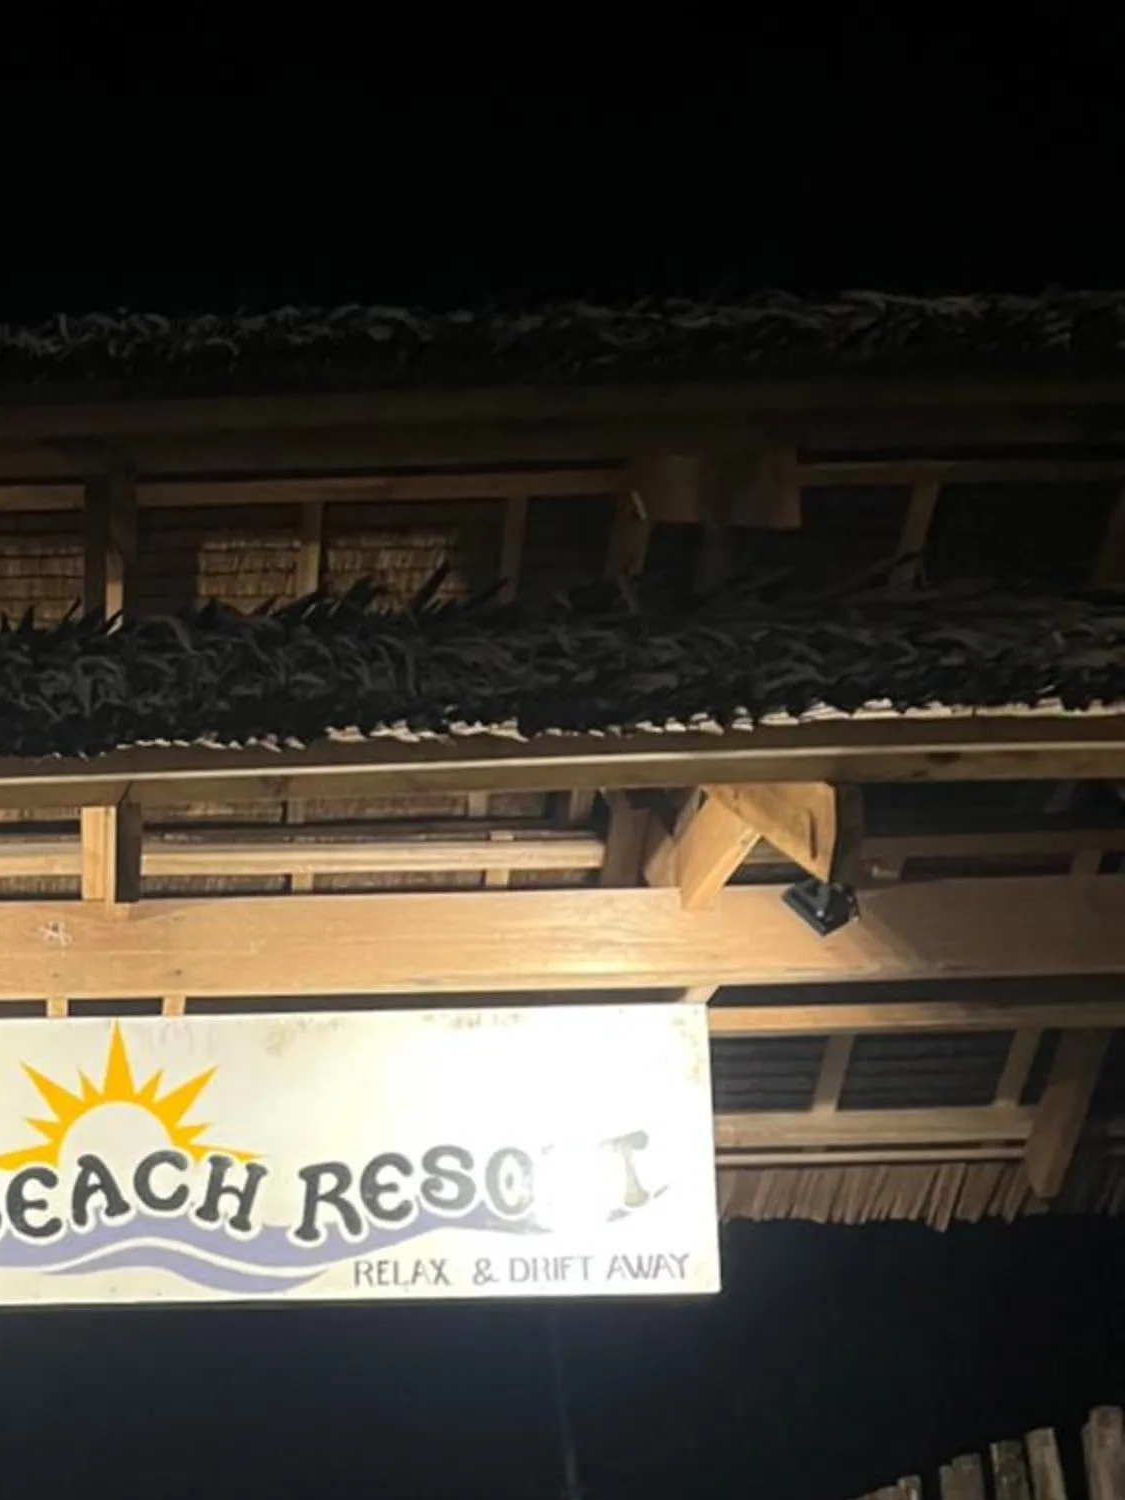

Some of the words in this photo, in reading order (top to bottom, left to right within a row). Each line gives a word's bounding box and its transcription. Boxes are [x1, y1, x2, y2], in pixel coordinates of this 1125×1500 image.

[293, 1130, 651, 1242] RESOT
[354, 1258, 450, 1287] RELAX
[472, 1257, 500, 1286] &
[509, 1255, 594, 1282] DRIFT
[606, 1252, 690, 1281] AWAY
